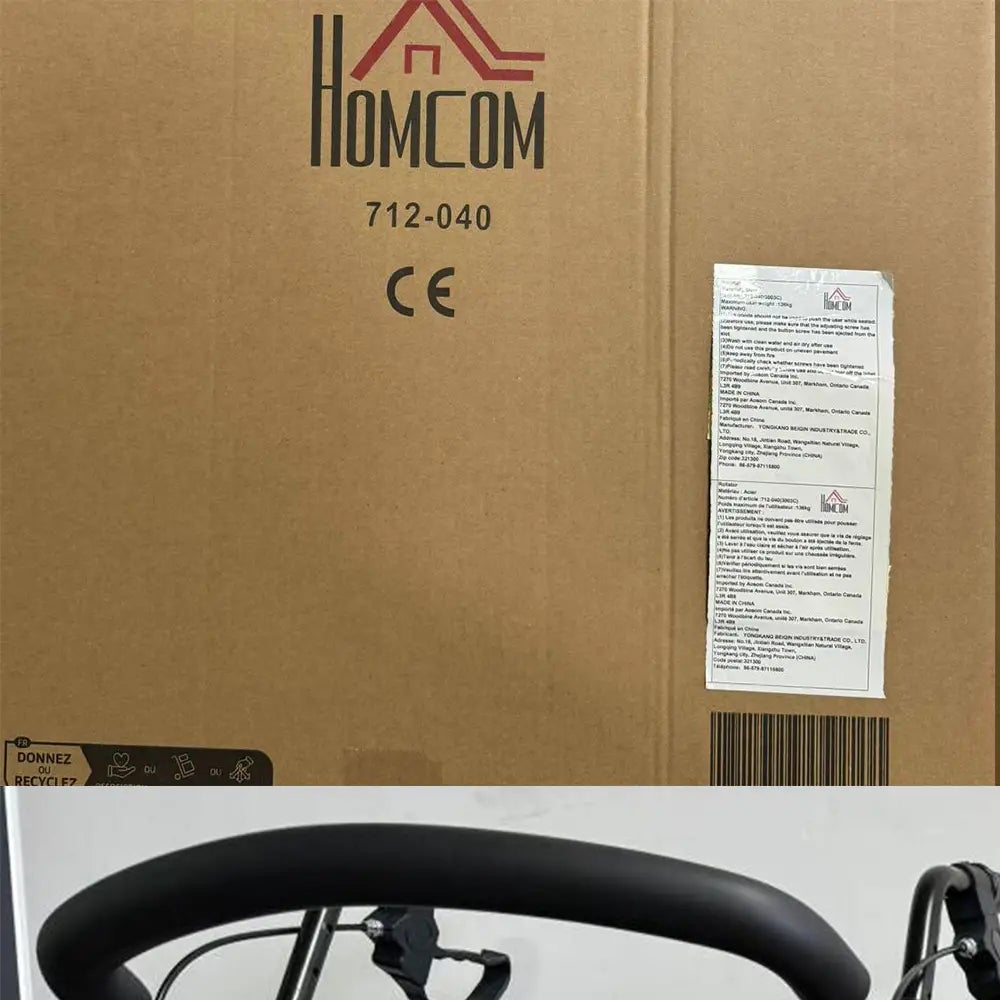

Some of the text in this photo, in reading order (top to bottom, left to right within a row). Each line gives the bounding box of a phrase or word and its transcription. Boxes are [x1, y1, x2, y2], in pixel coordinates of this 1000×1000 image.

[311, 15, 545, 169] HOMCOM
[366, 202, 491, 230] 712-040
[386, 266, 455, 317] CE
[17, 752, 72, 765] DONNEZ
[38, 766, 51, 775] OU
